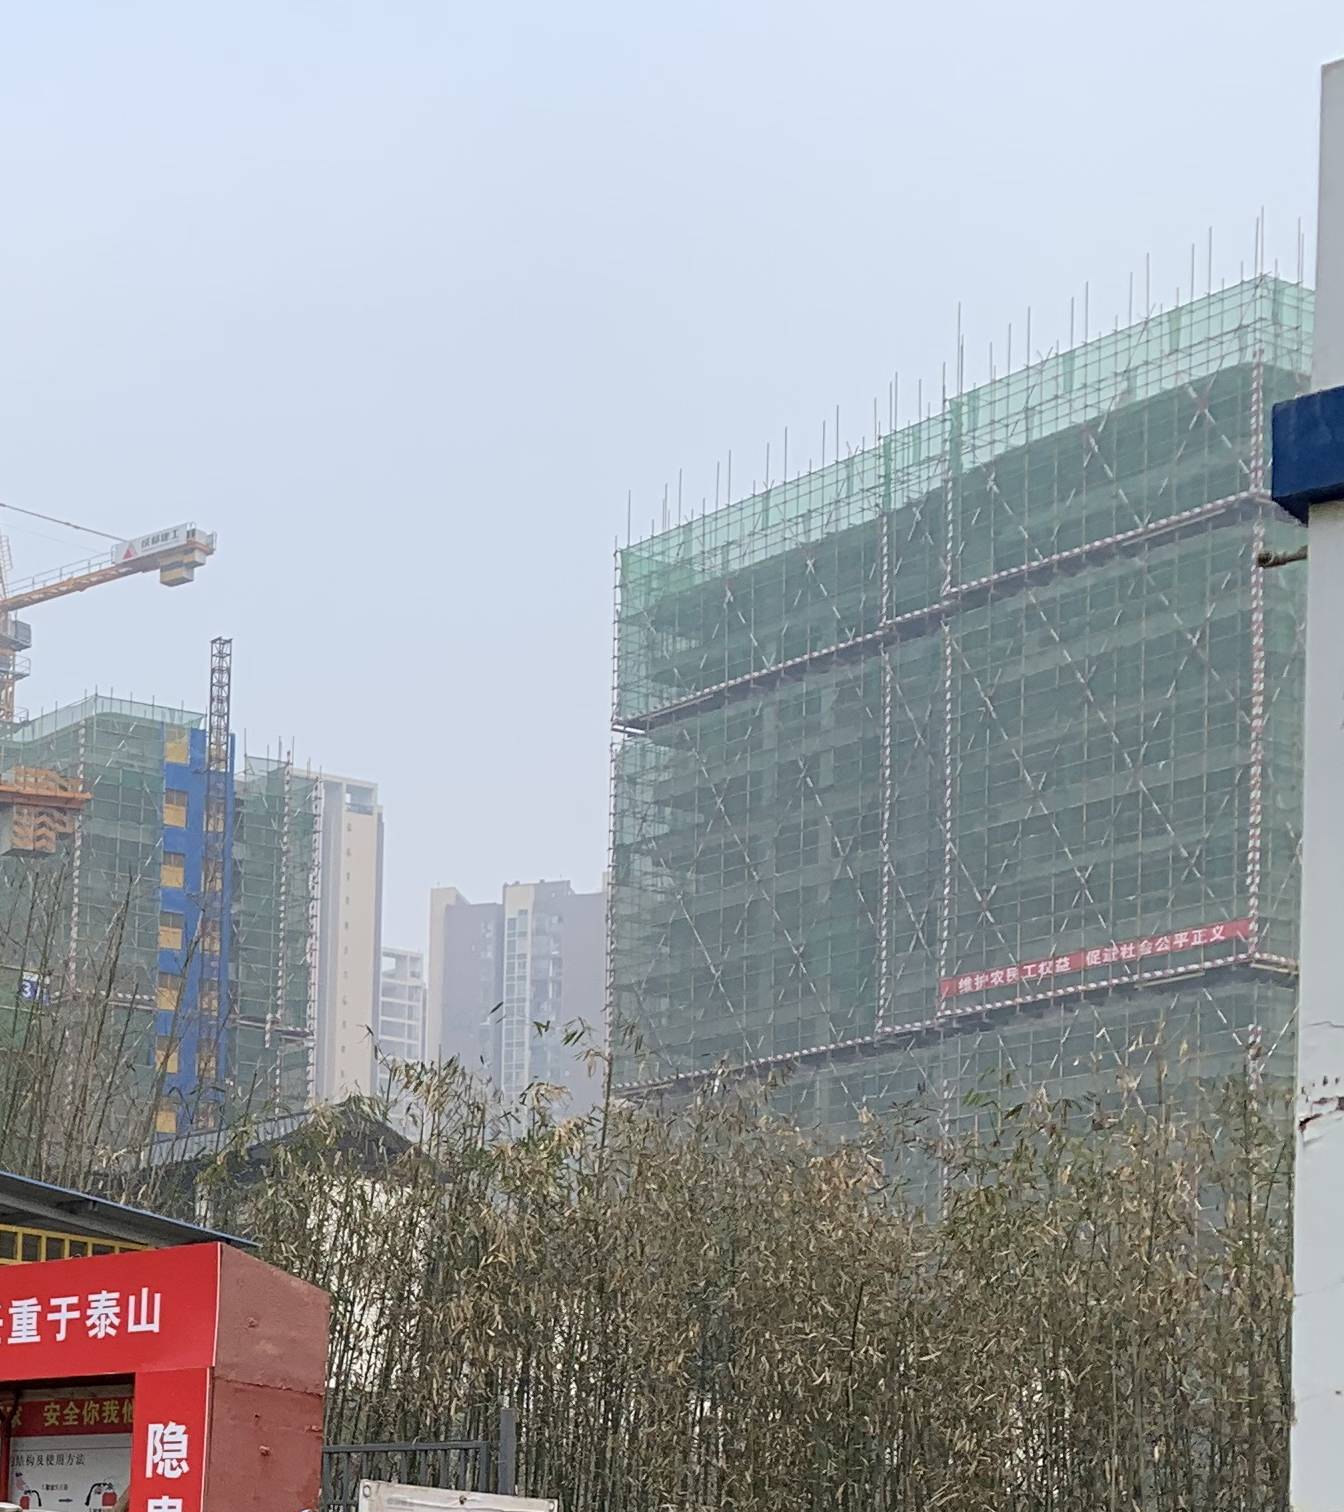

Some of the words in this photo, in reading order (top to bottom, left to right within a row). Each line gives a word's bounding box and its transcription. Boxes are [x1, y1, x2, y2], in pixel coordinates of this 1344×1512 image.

[958, 956, 1071, 994] 维护农民工权益
[1085, 925, 1226, 966] 促进社会公平正义
